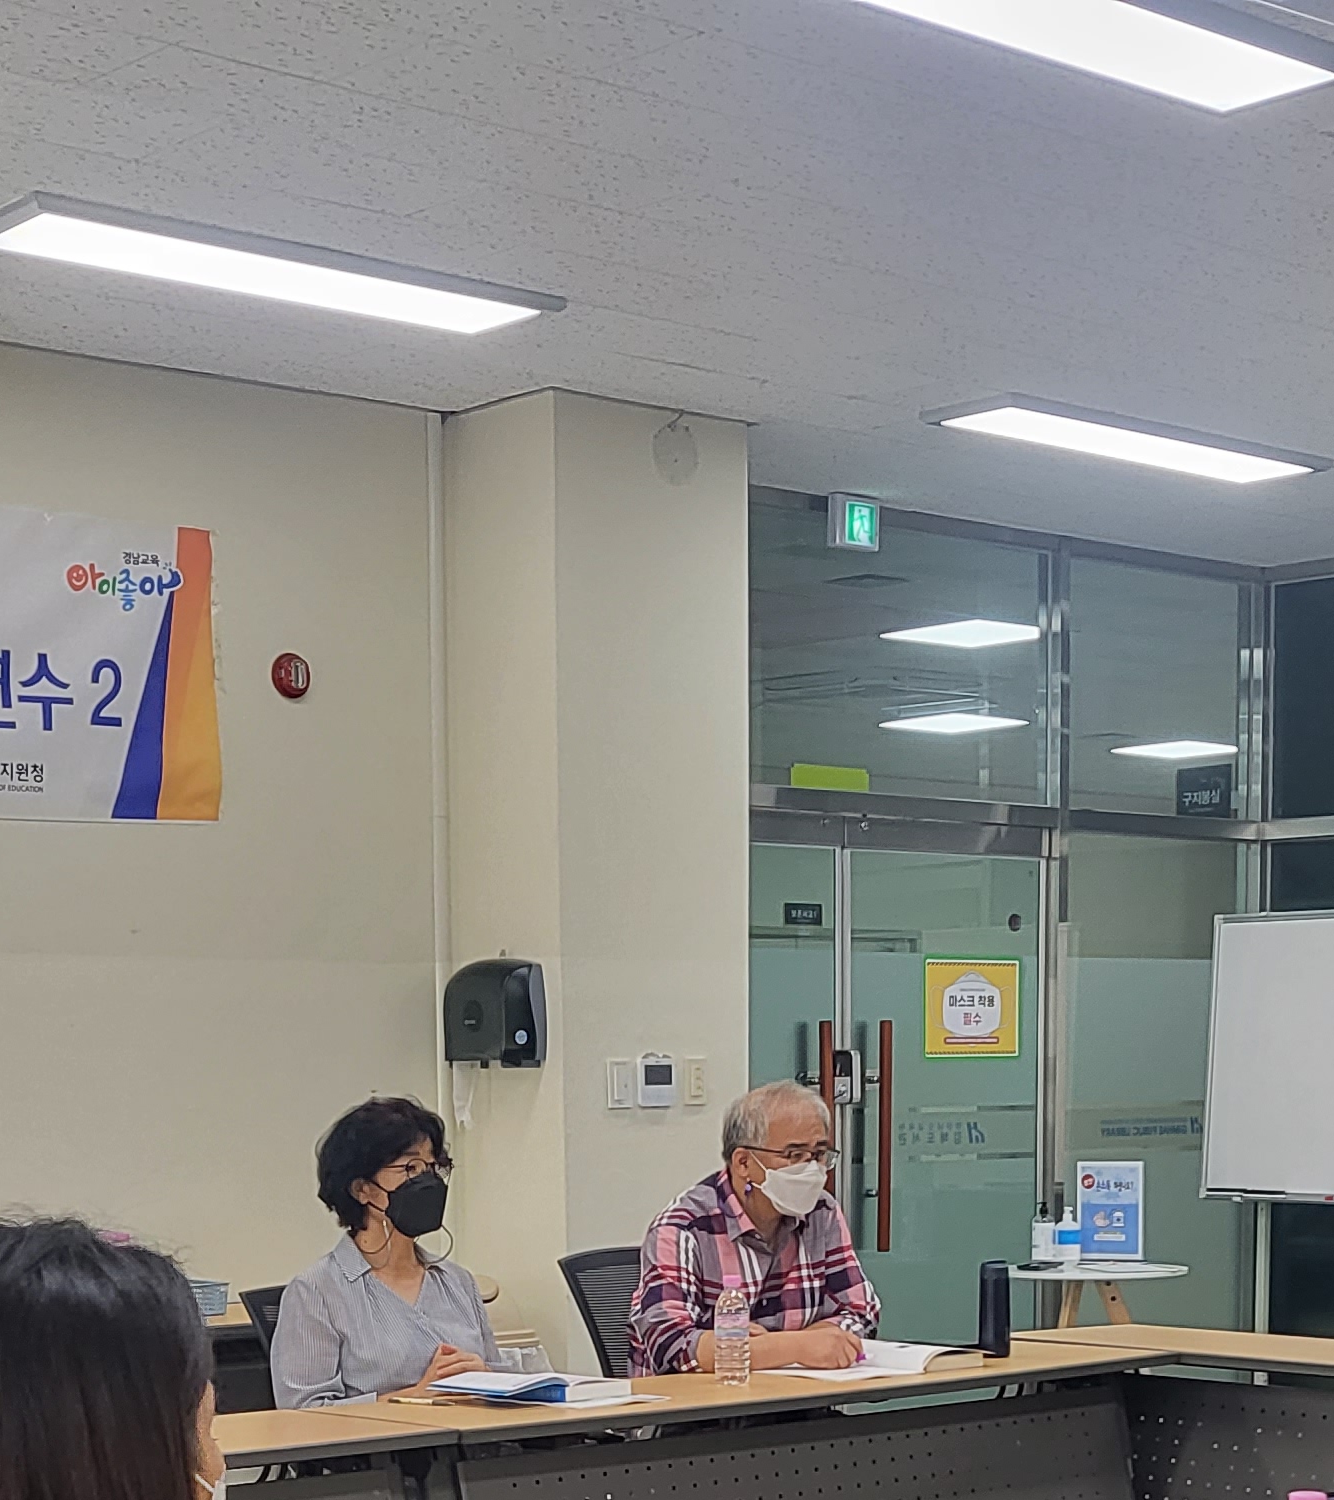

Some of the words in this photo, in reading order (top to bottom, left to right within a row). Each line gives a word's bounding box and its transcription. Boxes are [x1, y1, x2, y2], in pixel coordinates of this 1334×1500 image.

[122, 551, 160, 568] 경남교육
[90, 658, 123, 728] 2
[7, 784, 44, 793] EDUCATION
[1182, 788, 1220, 807] 구지봉실
[948, 995, 975, 1008] 마스크
[977, 995, 995, 1008] 착용
[963, 1012, 983, 1026] 필수
